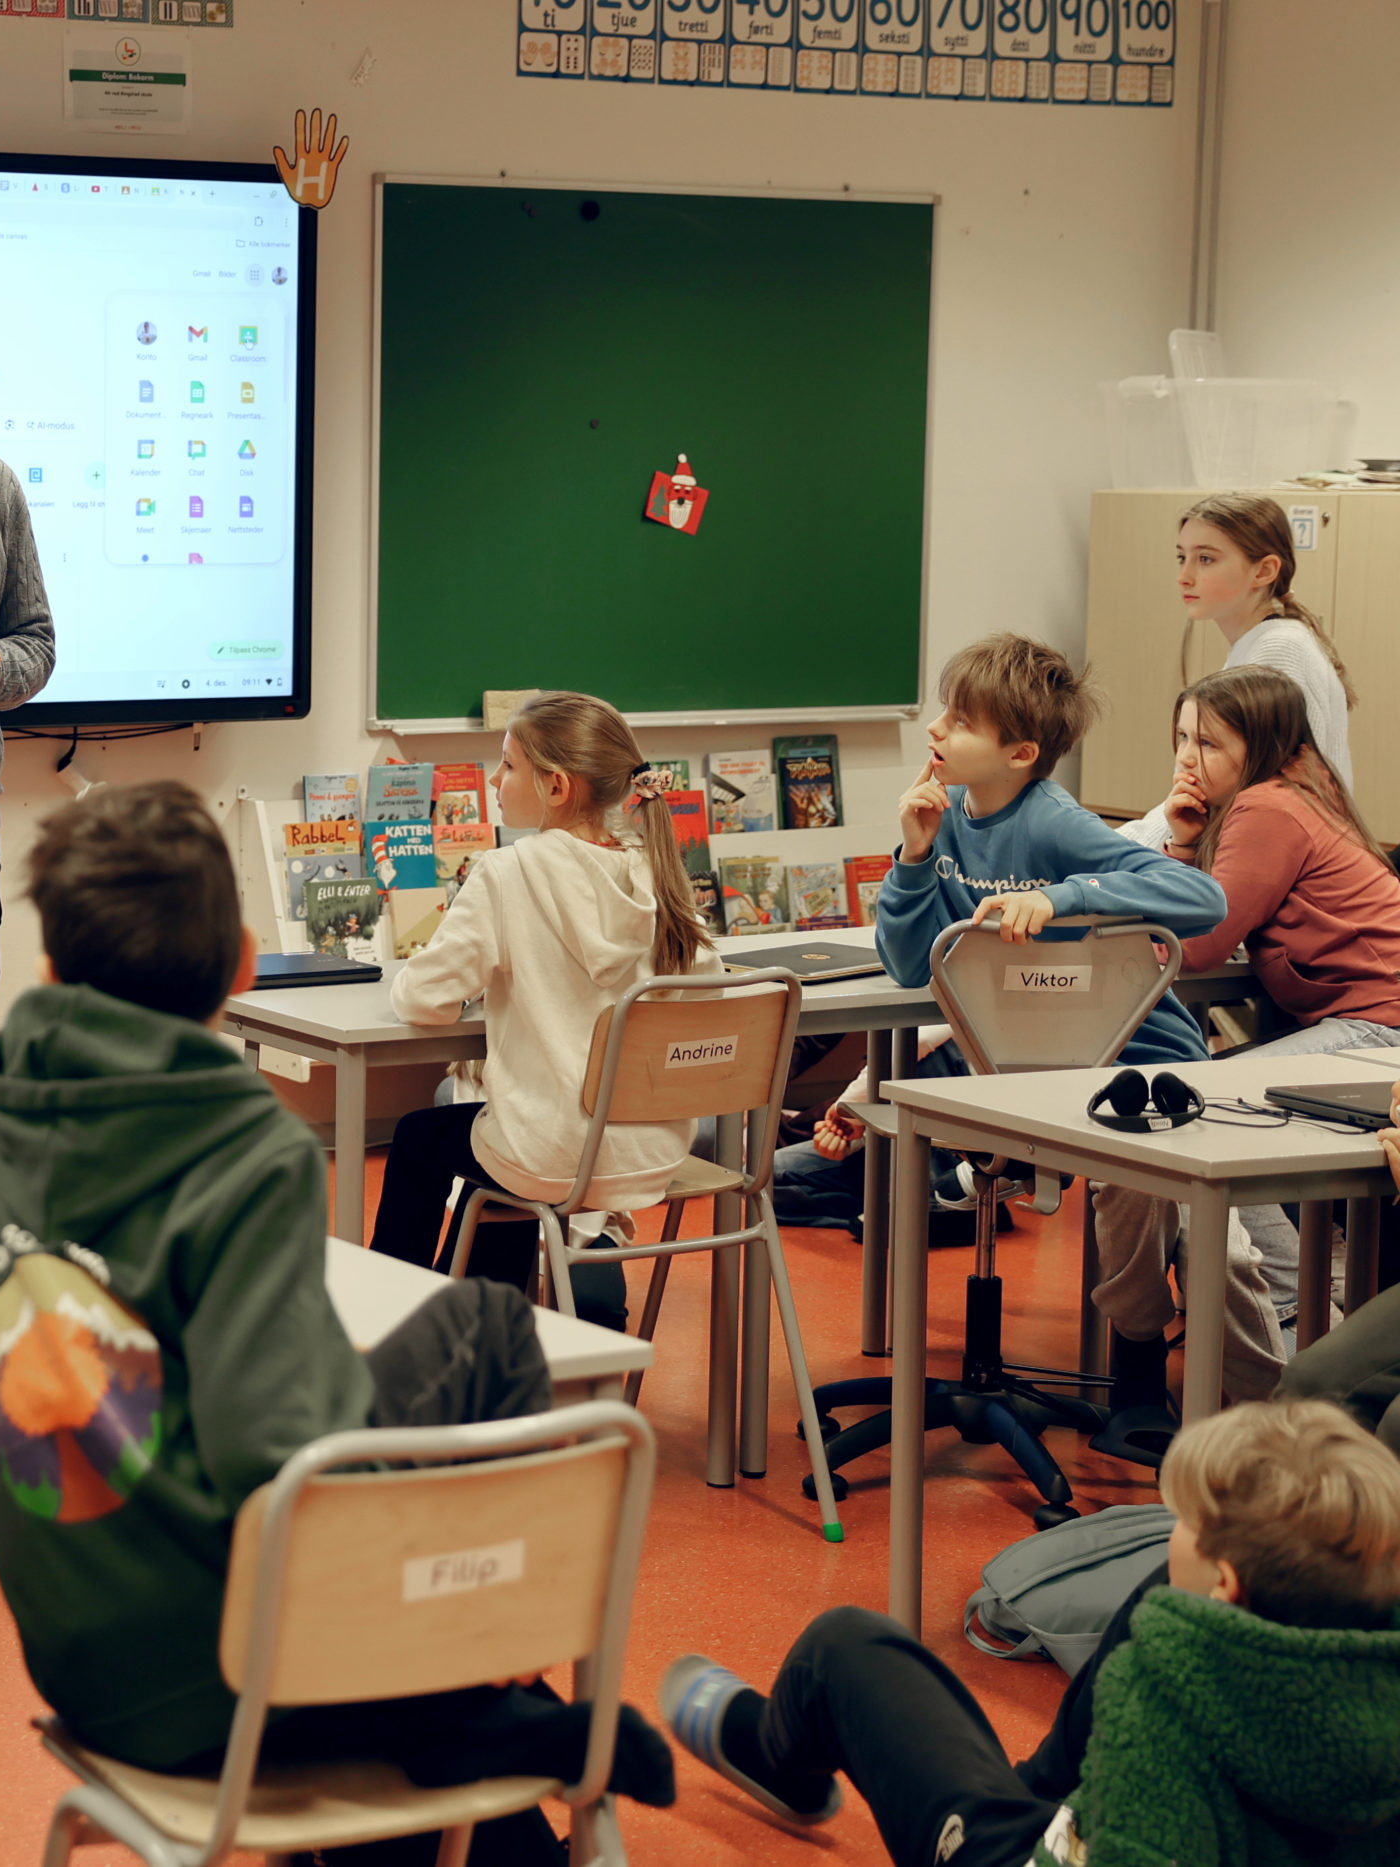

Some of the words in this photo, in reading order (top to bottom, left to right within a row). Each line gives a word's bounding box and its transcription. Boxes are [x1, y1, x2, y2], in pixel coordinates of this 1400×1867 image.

[543, 9, 556, 28] ti
[611, 12, 637, 32] tjue
[998, 0, 1048, 33] 80
[1061, 0, 1110, 37] 90
[1122, 0, 1171, 30] 100
[678, 19, 709, 33] tretti
[747, 20, 774, 39] førti
[878, 31, 910, 45] seksti
[295, 158, 328, 200] H
[193, 270, 211, 278] Gmail
[136, 353, 157, 362] Konto
[188, 353, 208, 362] Gmail
[230, 354, 266, 363] Classroom
[181, 411, 213, 420] Regneark
[130, 468, 161, 477] Kalender
[188, 468, 205, 477] Chat
[239, 468, 254, 477] Disk
[136, 526, 154, 534] Meet
[385, 824, 433, 838] KATTEN
[388, 844, 434, 858] HATTEN
[935, 855, 1052, 894] Champion
[317, 886, 336, 902] ELLI
[345, 884, 372, 898] ENTER
[1020, 971, 1078, 988] Viktor
[669, 1043, 733, 1062] Andrine
[431, 1556, 500, 1589] Filip
